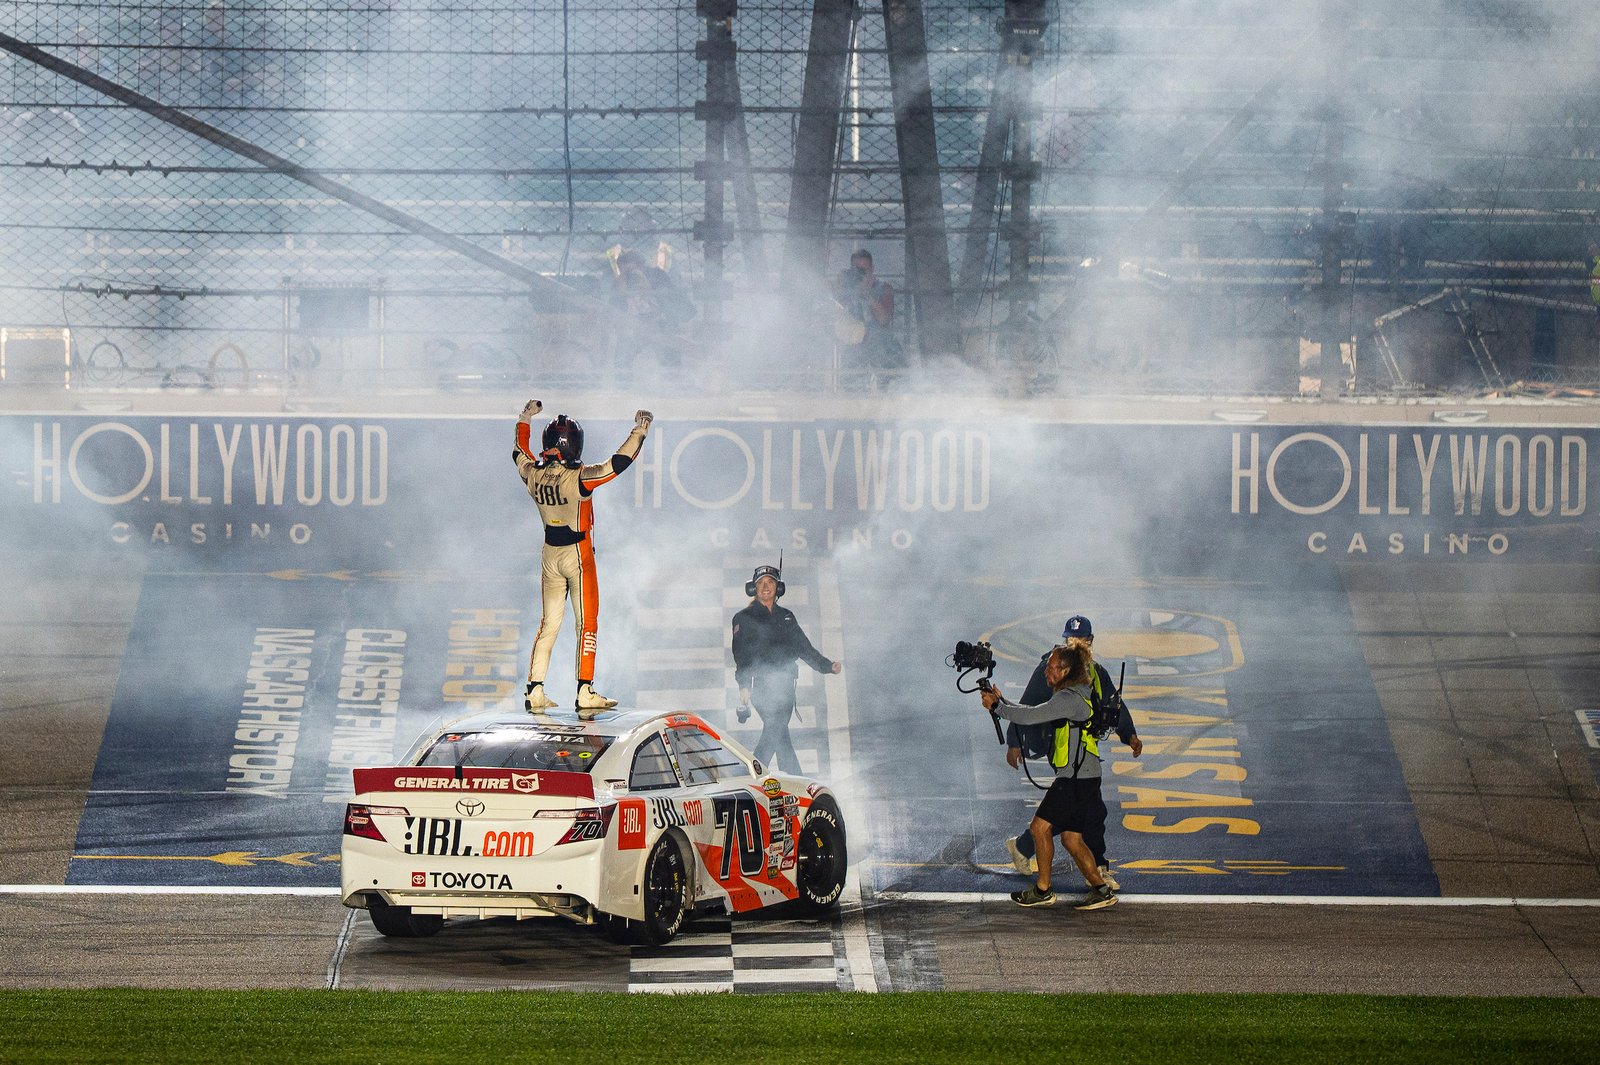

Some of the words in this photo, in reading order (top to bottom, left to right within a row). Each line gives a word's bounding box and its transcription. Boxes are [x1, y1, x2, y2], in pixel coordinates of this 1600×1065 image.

[33, 421, 390, 507] HOLLYWOOD
[633, 426, 991, 513] HOLLYWOOD
[1230, 431, 1588, 517] HOLLYWOOD
[110, 521, 313, 545] CASINO
[710, 526, 913, 551] CASINO
[1306, 531, 1509, 555] CASINO
[447, 607, 521, 677] HOME
[242, 627, 316, 709] NASCAR
[336, 628, 408, 713] CLOSEST
[225, 709, 302, 799] HISTORY
[1109, 685, 1262, 836] KANSAS
[393, 776, 471, 789] GENERAL
[472, 777, 510, 790] TIRE
[569, 820, 603, 841] 70
[623, 808, 641, 834] JBL
[707, 788, 765, 881] 70
[801, 809, 837, 829] GENERAL
[429, 871, 513, 890] TOYOTA
[806, 882, 841, 905] GENERAL
